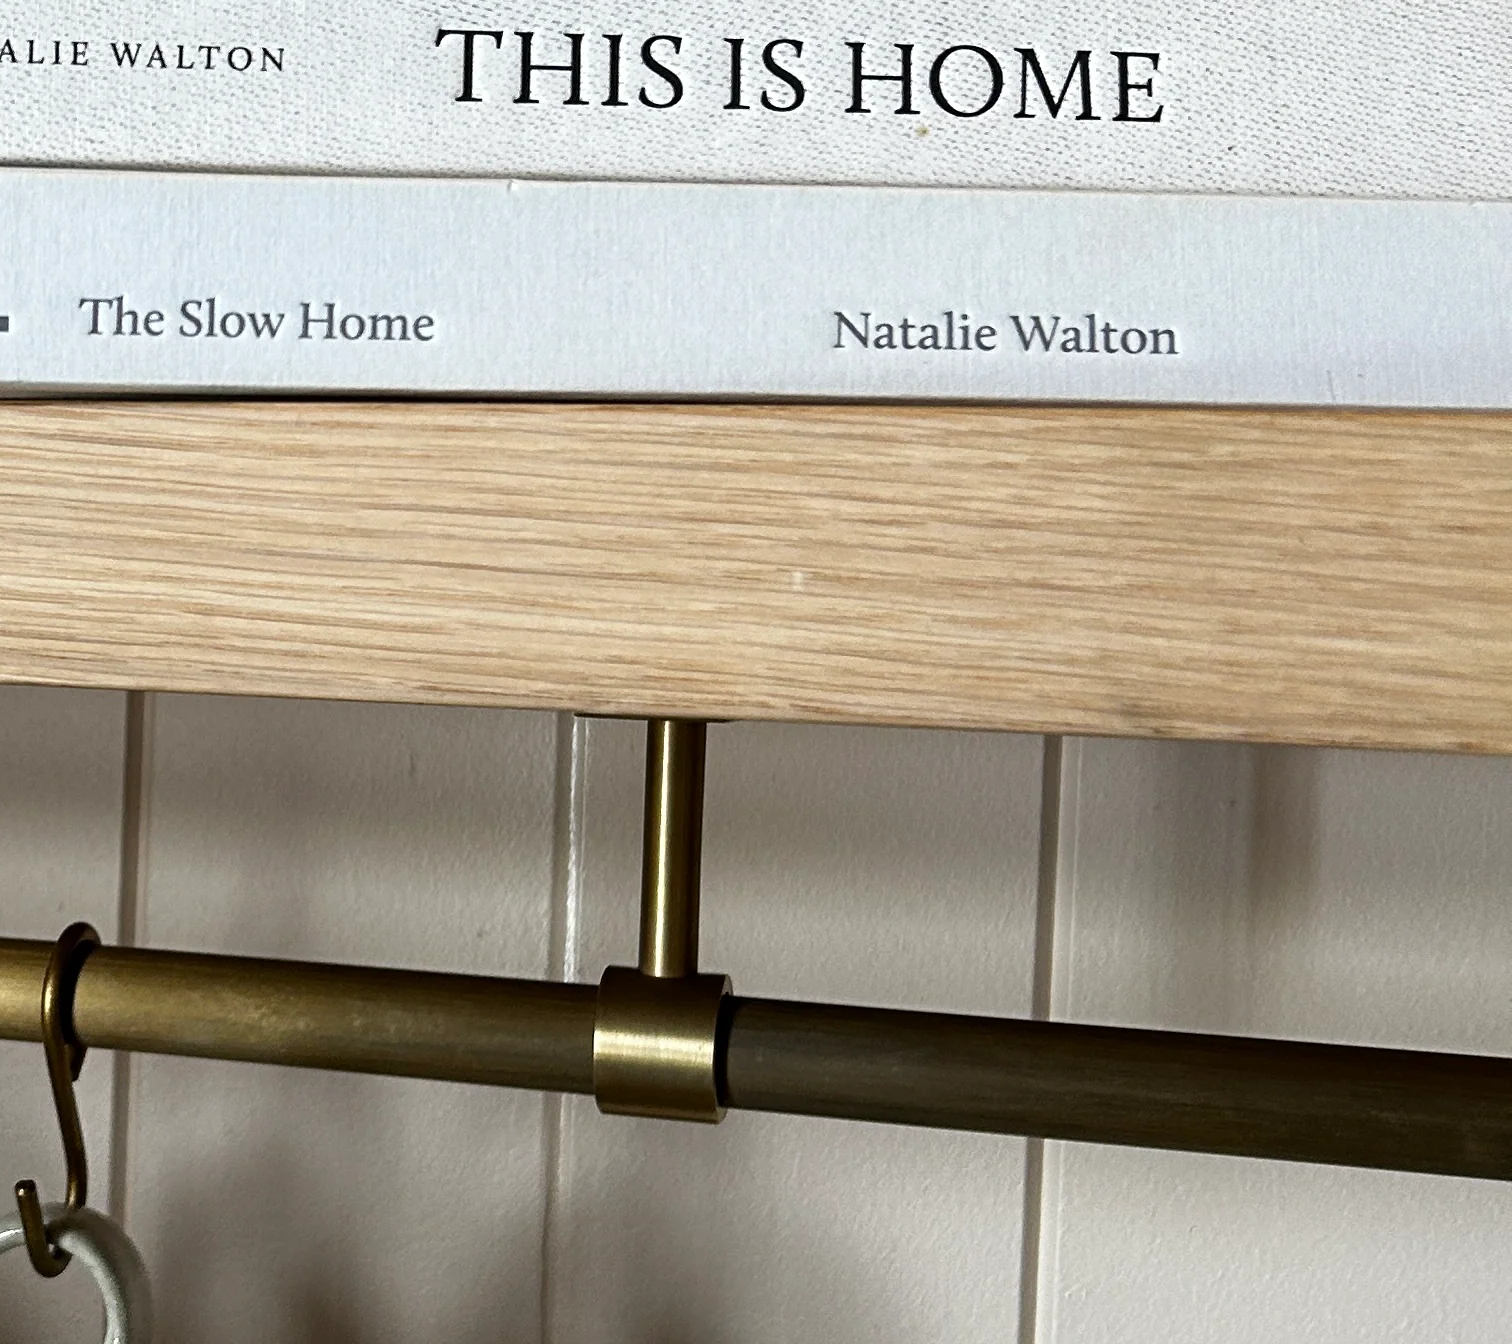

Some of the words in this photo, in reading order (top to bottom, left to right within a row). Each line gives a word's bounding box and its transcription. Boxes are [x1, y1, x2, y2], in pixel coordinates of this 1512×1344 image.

[110, 41, 285, 72] WALTON
[434, 28, 684, 109] THIS
[722, 37, 808, 113] IS
[844, 41, 1164, 123] HOME
[78, 295, 165, 338] The
[179, 297, 285, 339] Slow
[298, 302, 435, 342] Home
[833, 310, 997, 353] Natalie
[1009, 313, 1179, 356] Walton
